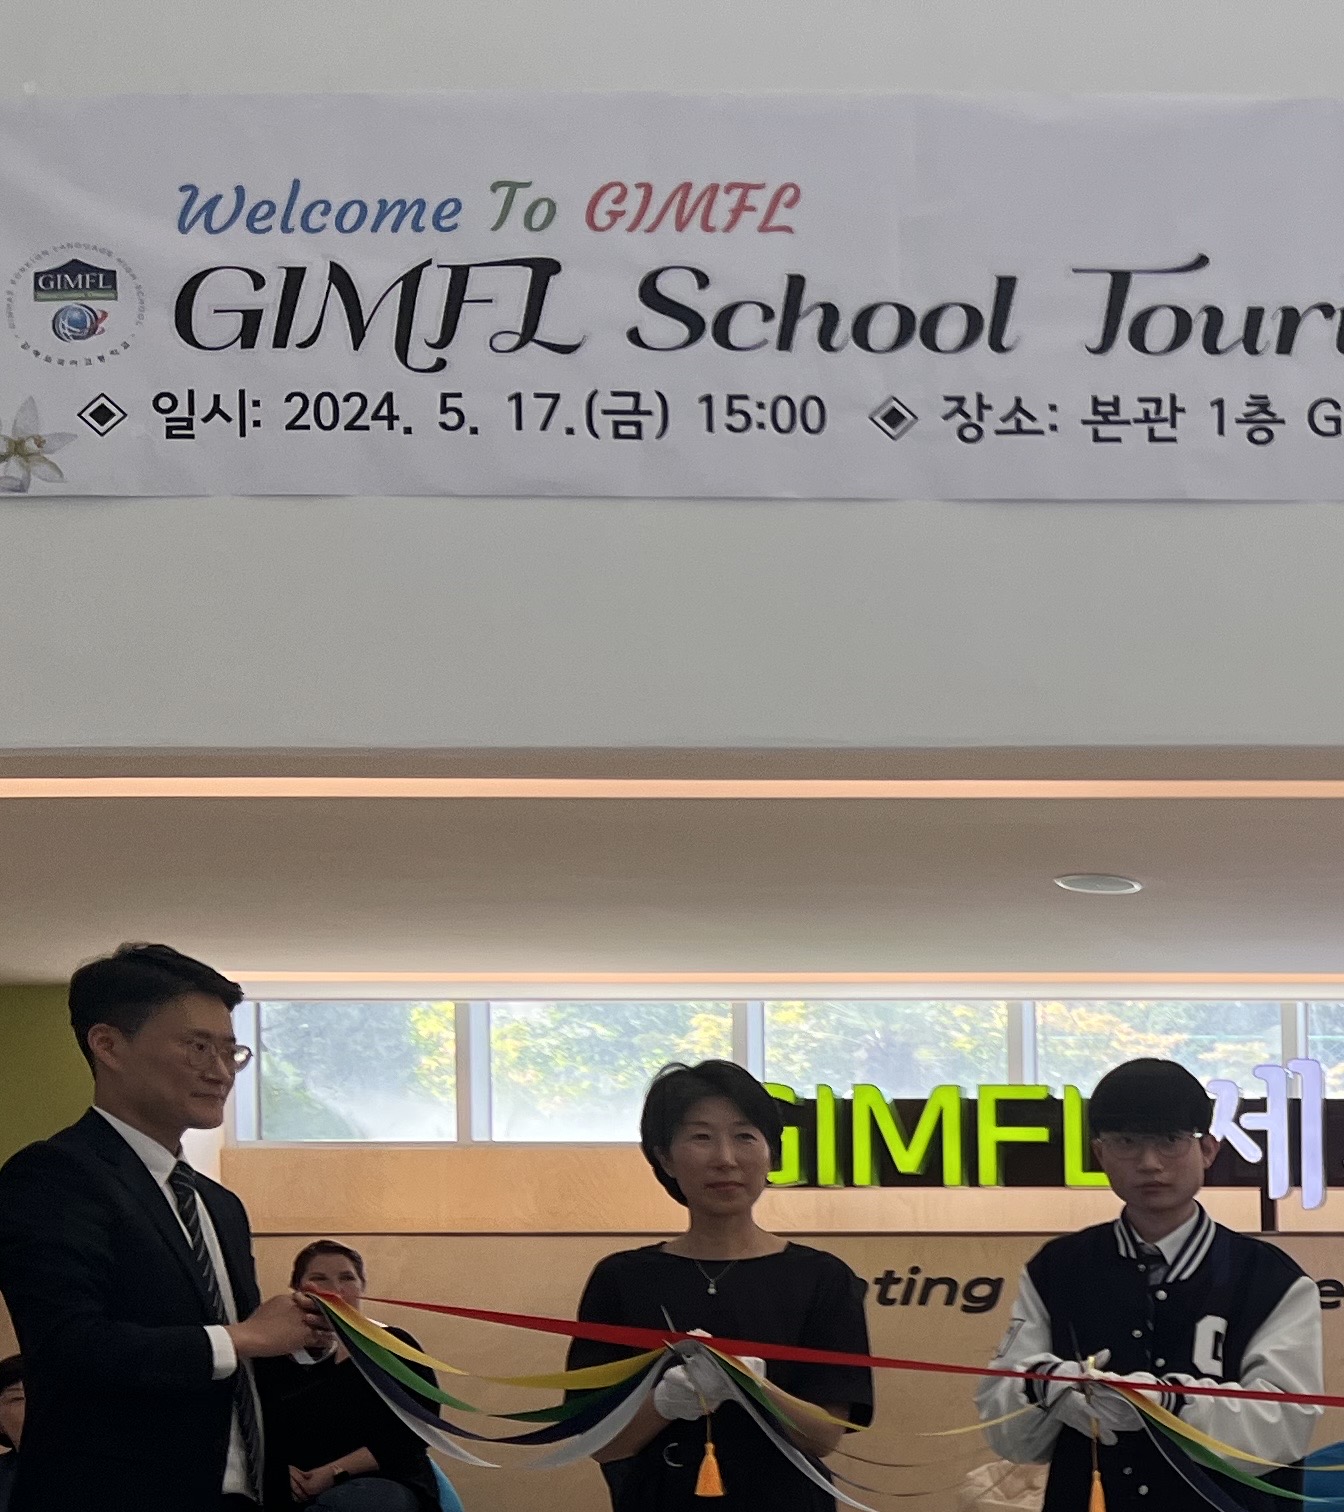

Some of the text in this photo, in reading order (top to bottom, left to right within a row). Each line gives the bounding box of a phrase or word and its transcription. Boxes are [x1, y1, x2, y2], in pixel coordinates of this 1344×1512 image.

[177, 178, 802, 235] Welcome To GIMFL
[38, 273, 112, 290] GIMFL
[174, 257, 586, 374] GIMFL
[626, 266, 1019, 354] School
[152, 389, 827, 440] 일시: 2024. 5. 17.(금) 15:00
[942, 392, 1059, 444] 장소:
[1081, 393, 1187, 443] 본관
[1210, 394, 1286, 446] 1층
[873, 1266, 1005, 1313] ting
